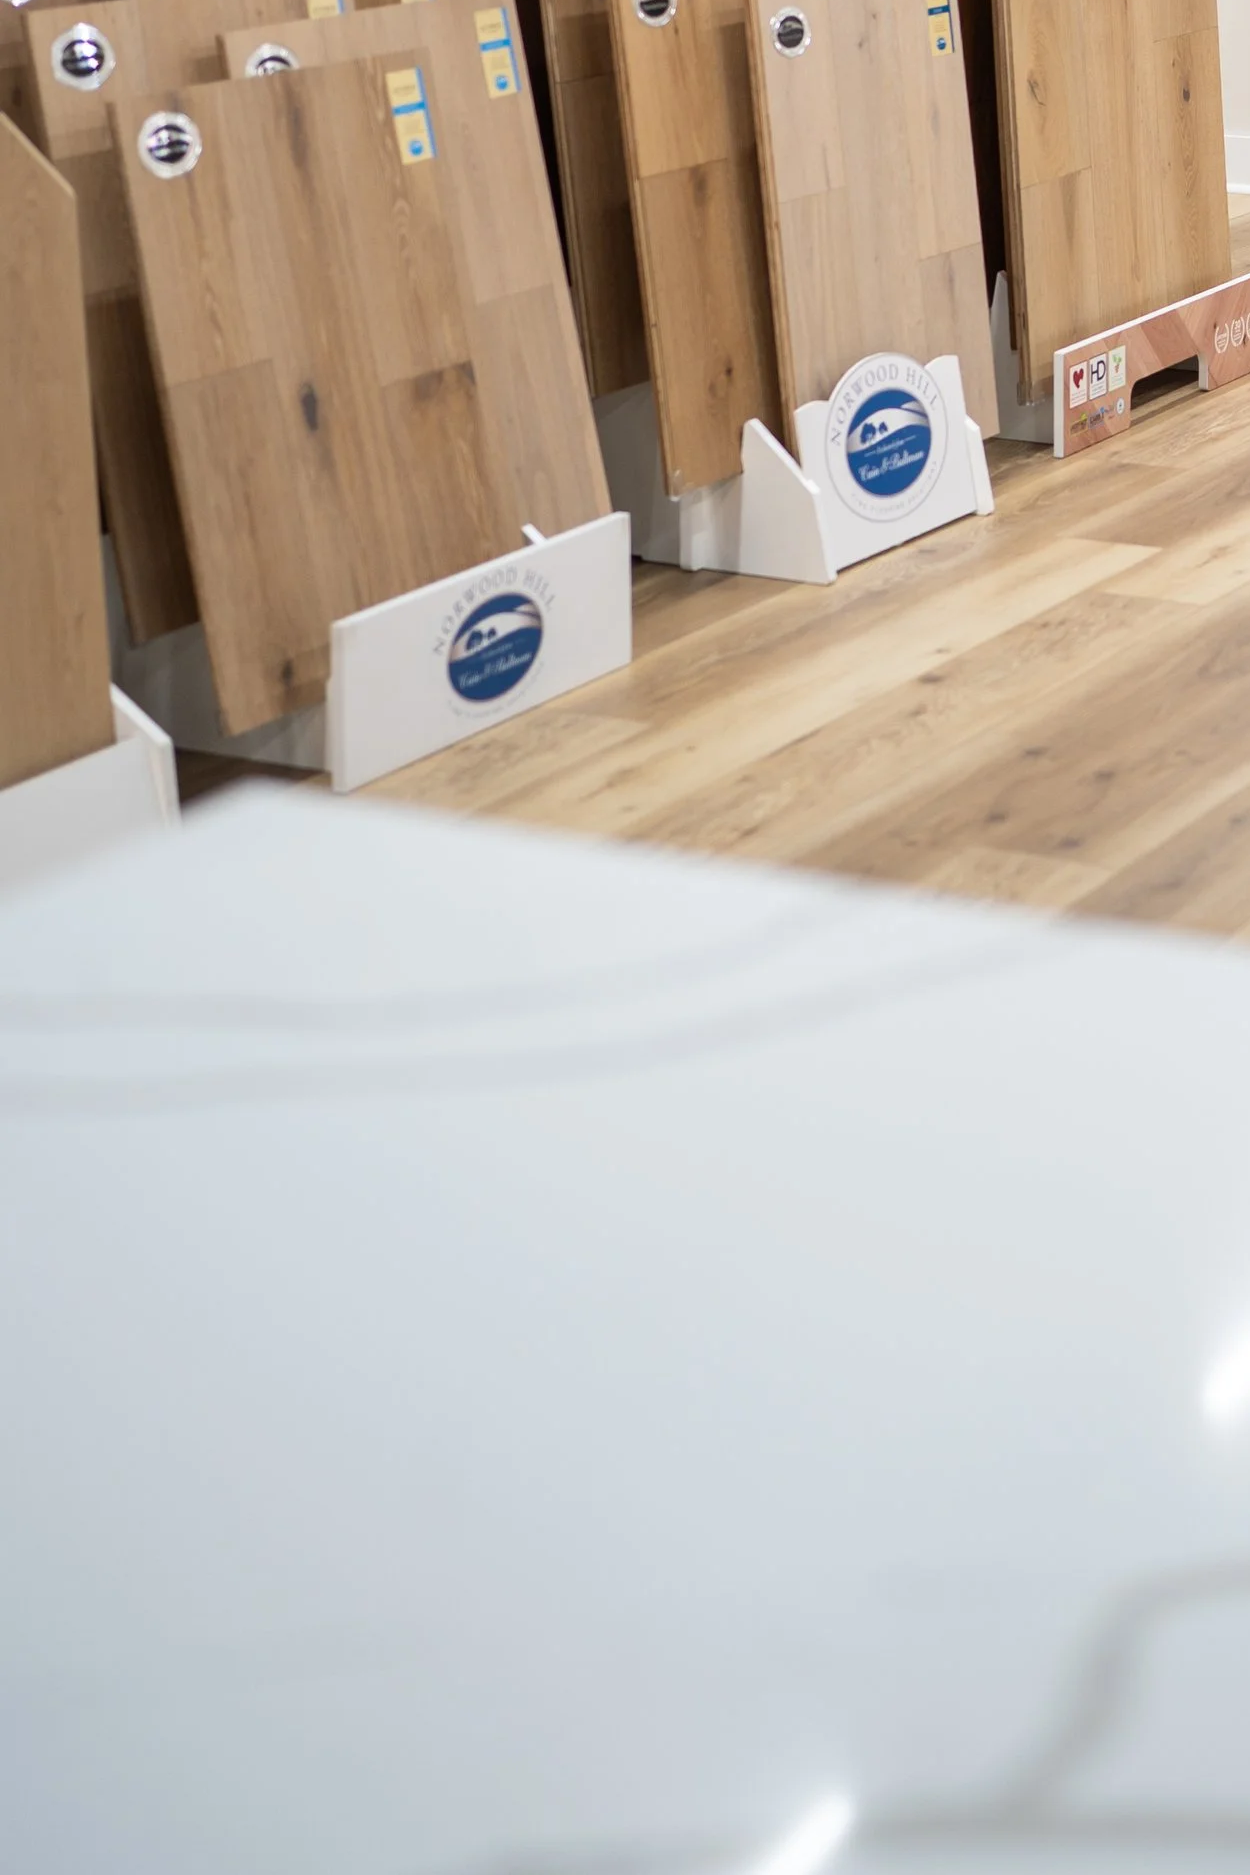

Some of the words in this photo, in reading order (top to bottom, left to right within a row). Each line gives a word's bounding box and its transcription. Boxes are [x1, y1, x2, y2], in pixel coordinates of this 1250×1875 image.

[831, 363, 900, 447] NORWOOD
[905, 366, 939, 412] HILL
[1090, 360, 1107, 385] HD
[431, 565, 519, 656] NORWOOD
[522, 568, 557, 614] HILL
